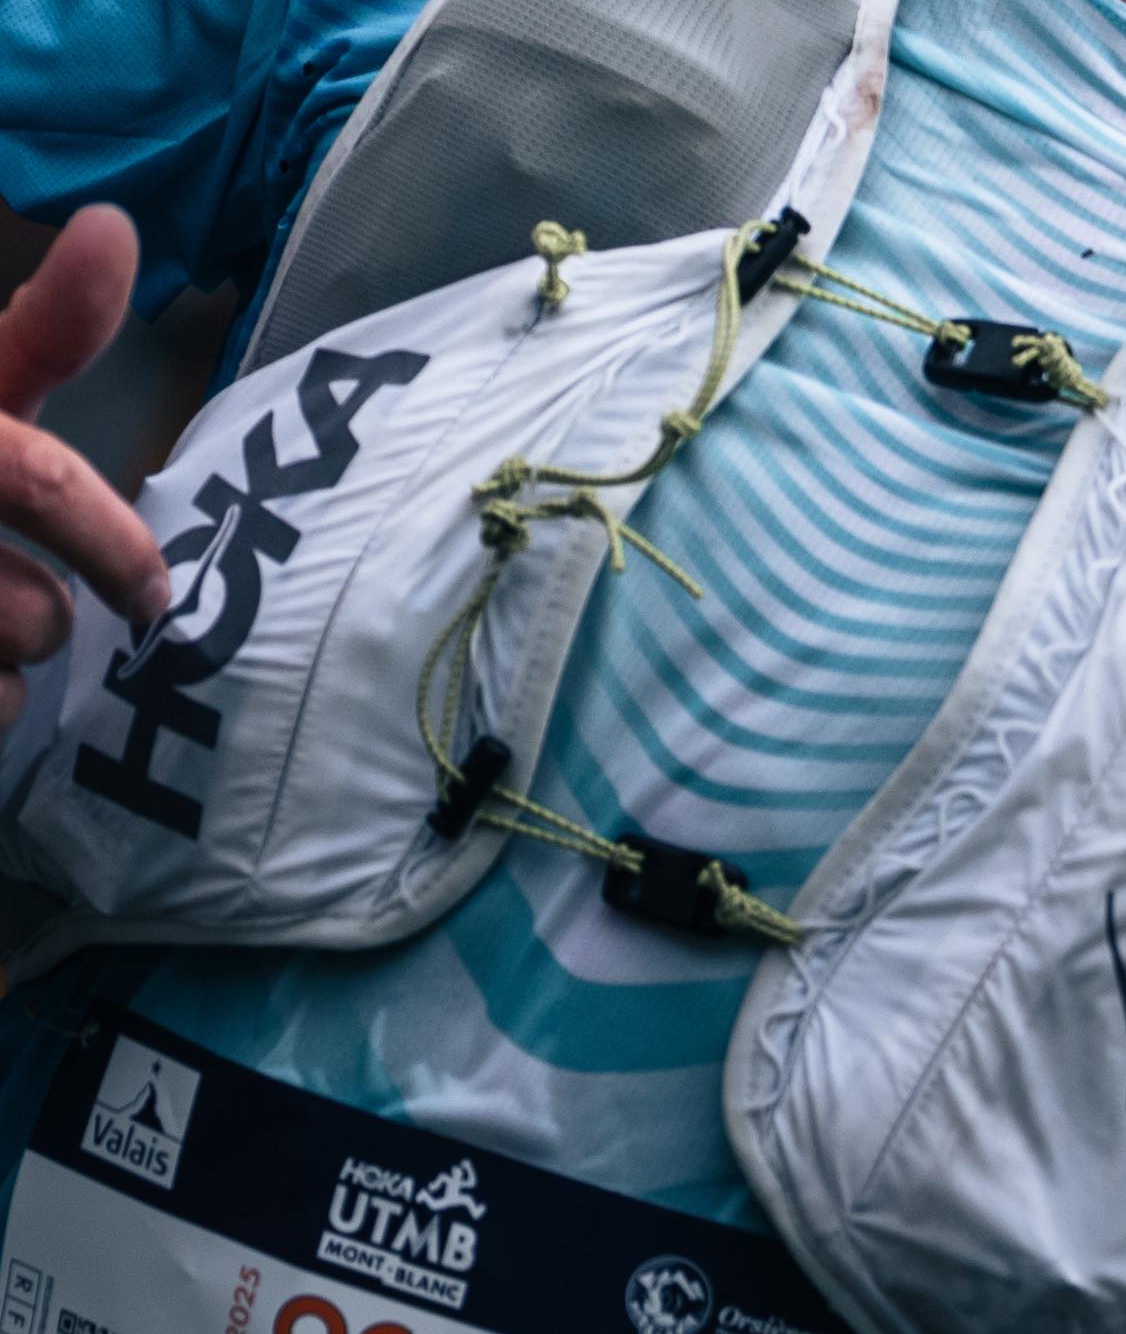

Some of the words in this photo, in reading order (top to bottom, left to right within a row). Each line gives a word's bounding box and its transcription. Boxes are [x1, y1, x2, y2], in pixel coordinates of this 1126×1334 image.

[94, 1113, 169, 1177] Valais
[338, 1156, 415, 1204] HOKA
[328, 1183, 479, 1273] UTMB
